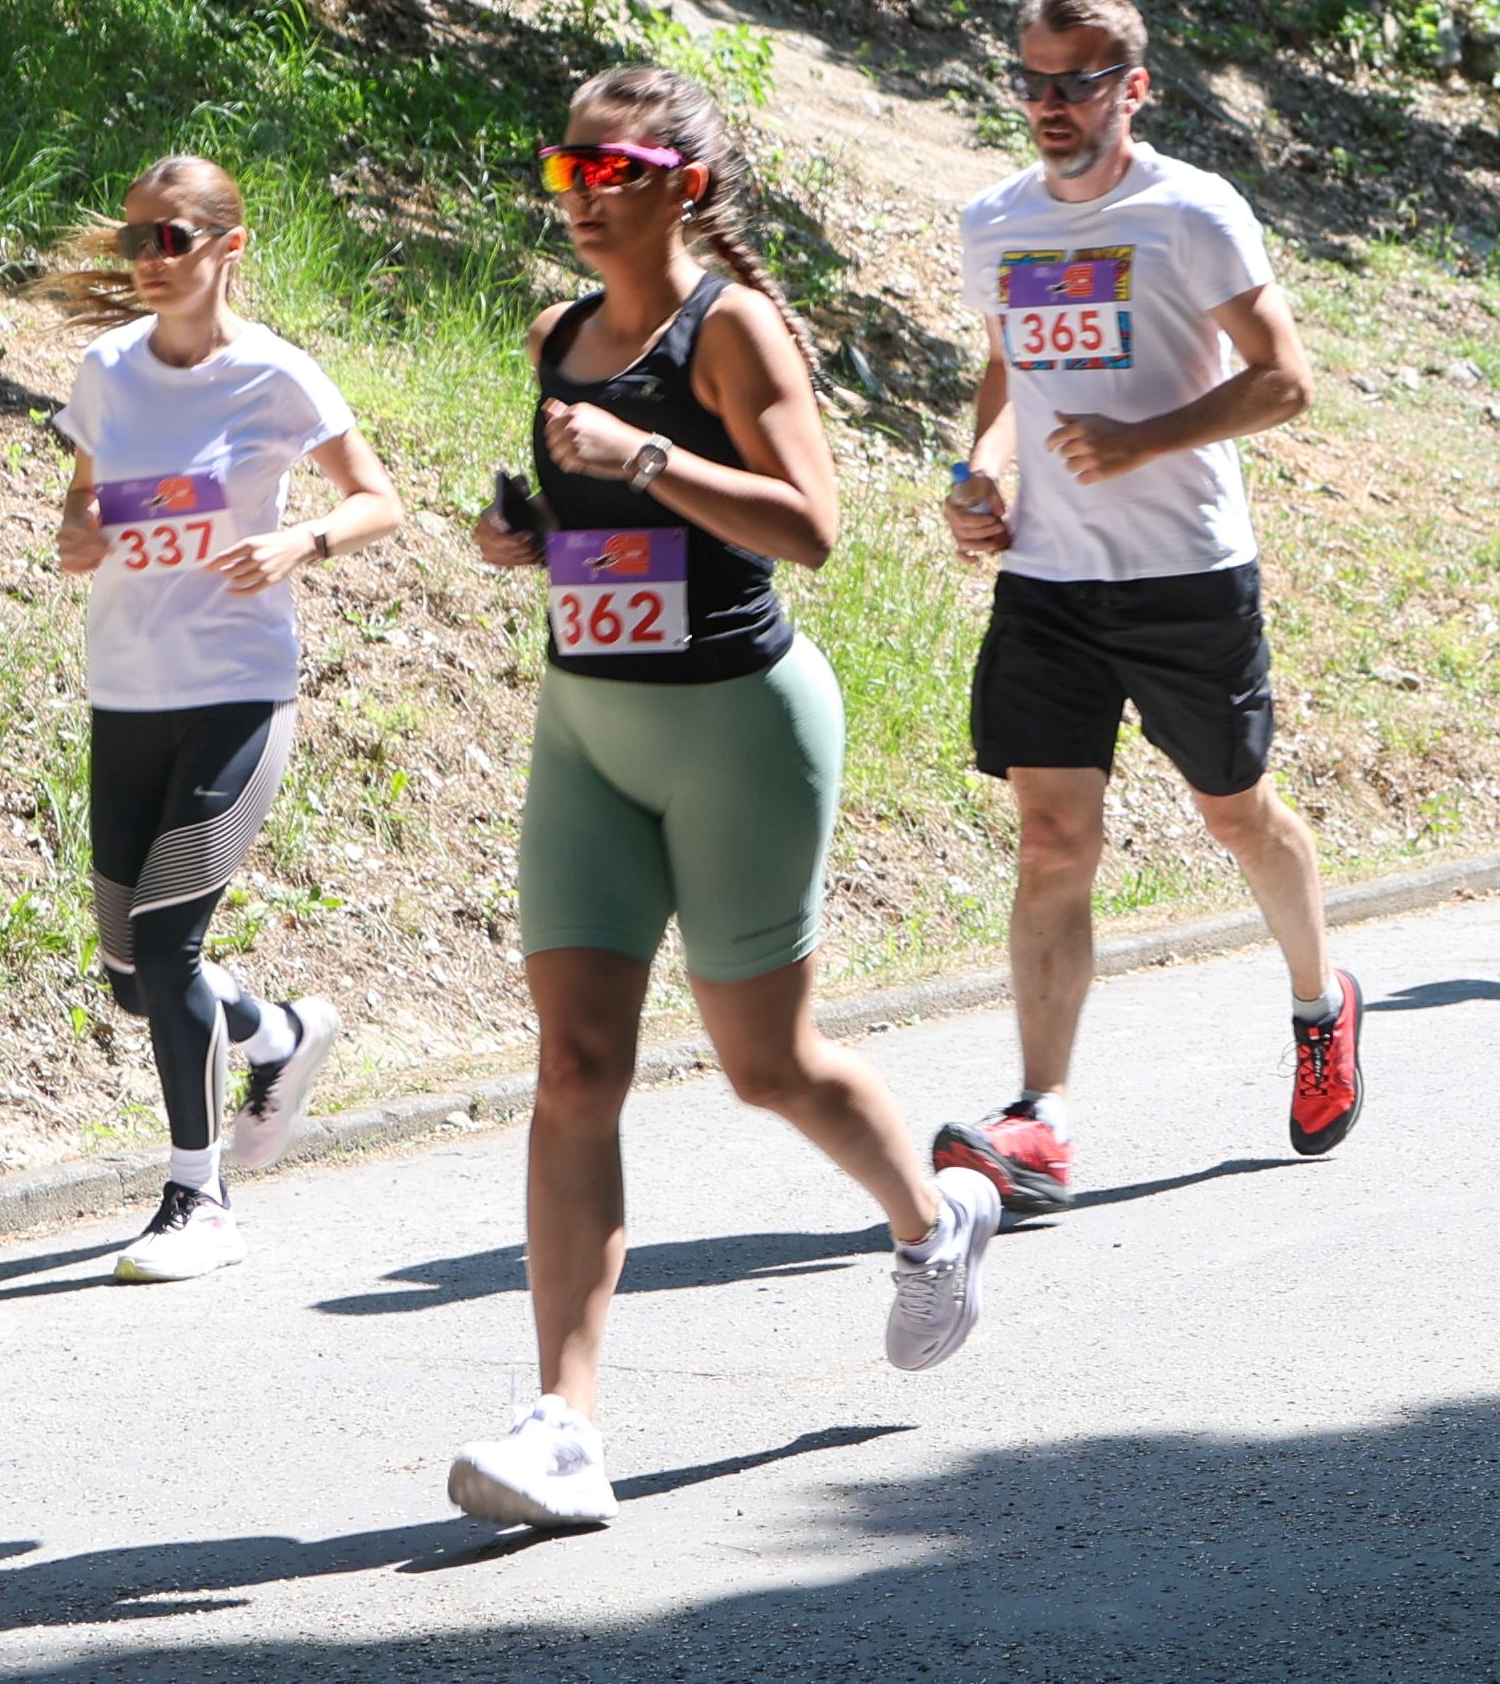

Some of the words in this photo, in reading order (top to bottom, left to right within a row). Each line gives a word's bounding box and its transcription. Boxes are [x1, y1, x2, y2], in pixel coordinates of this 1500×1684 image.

[1020, 310, 1104, 355] 365
[119, 519, 213, 570] 337
[559, 590, 666, 645] 362
